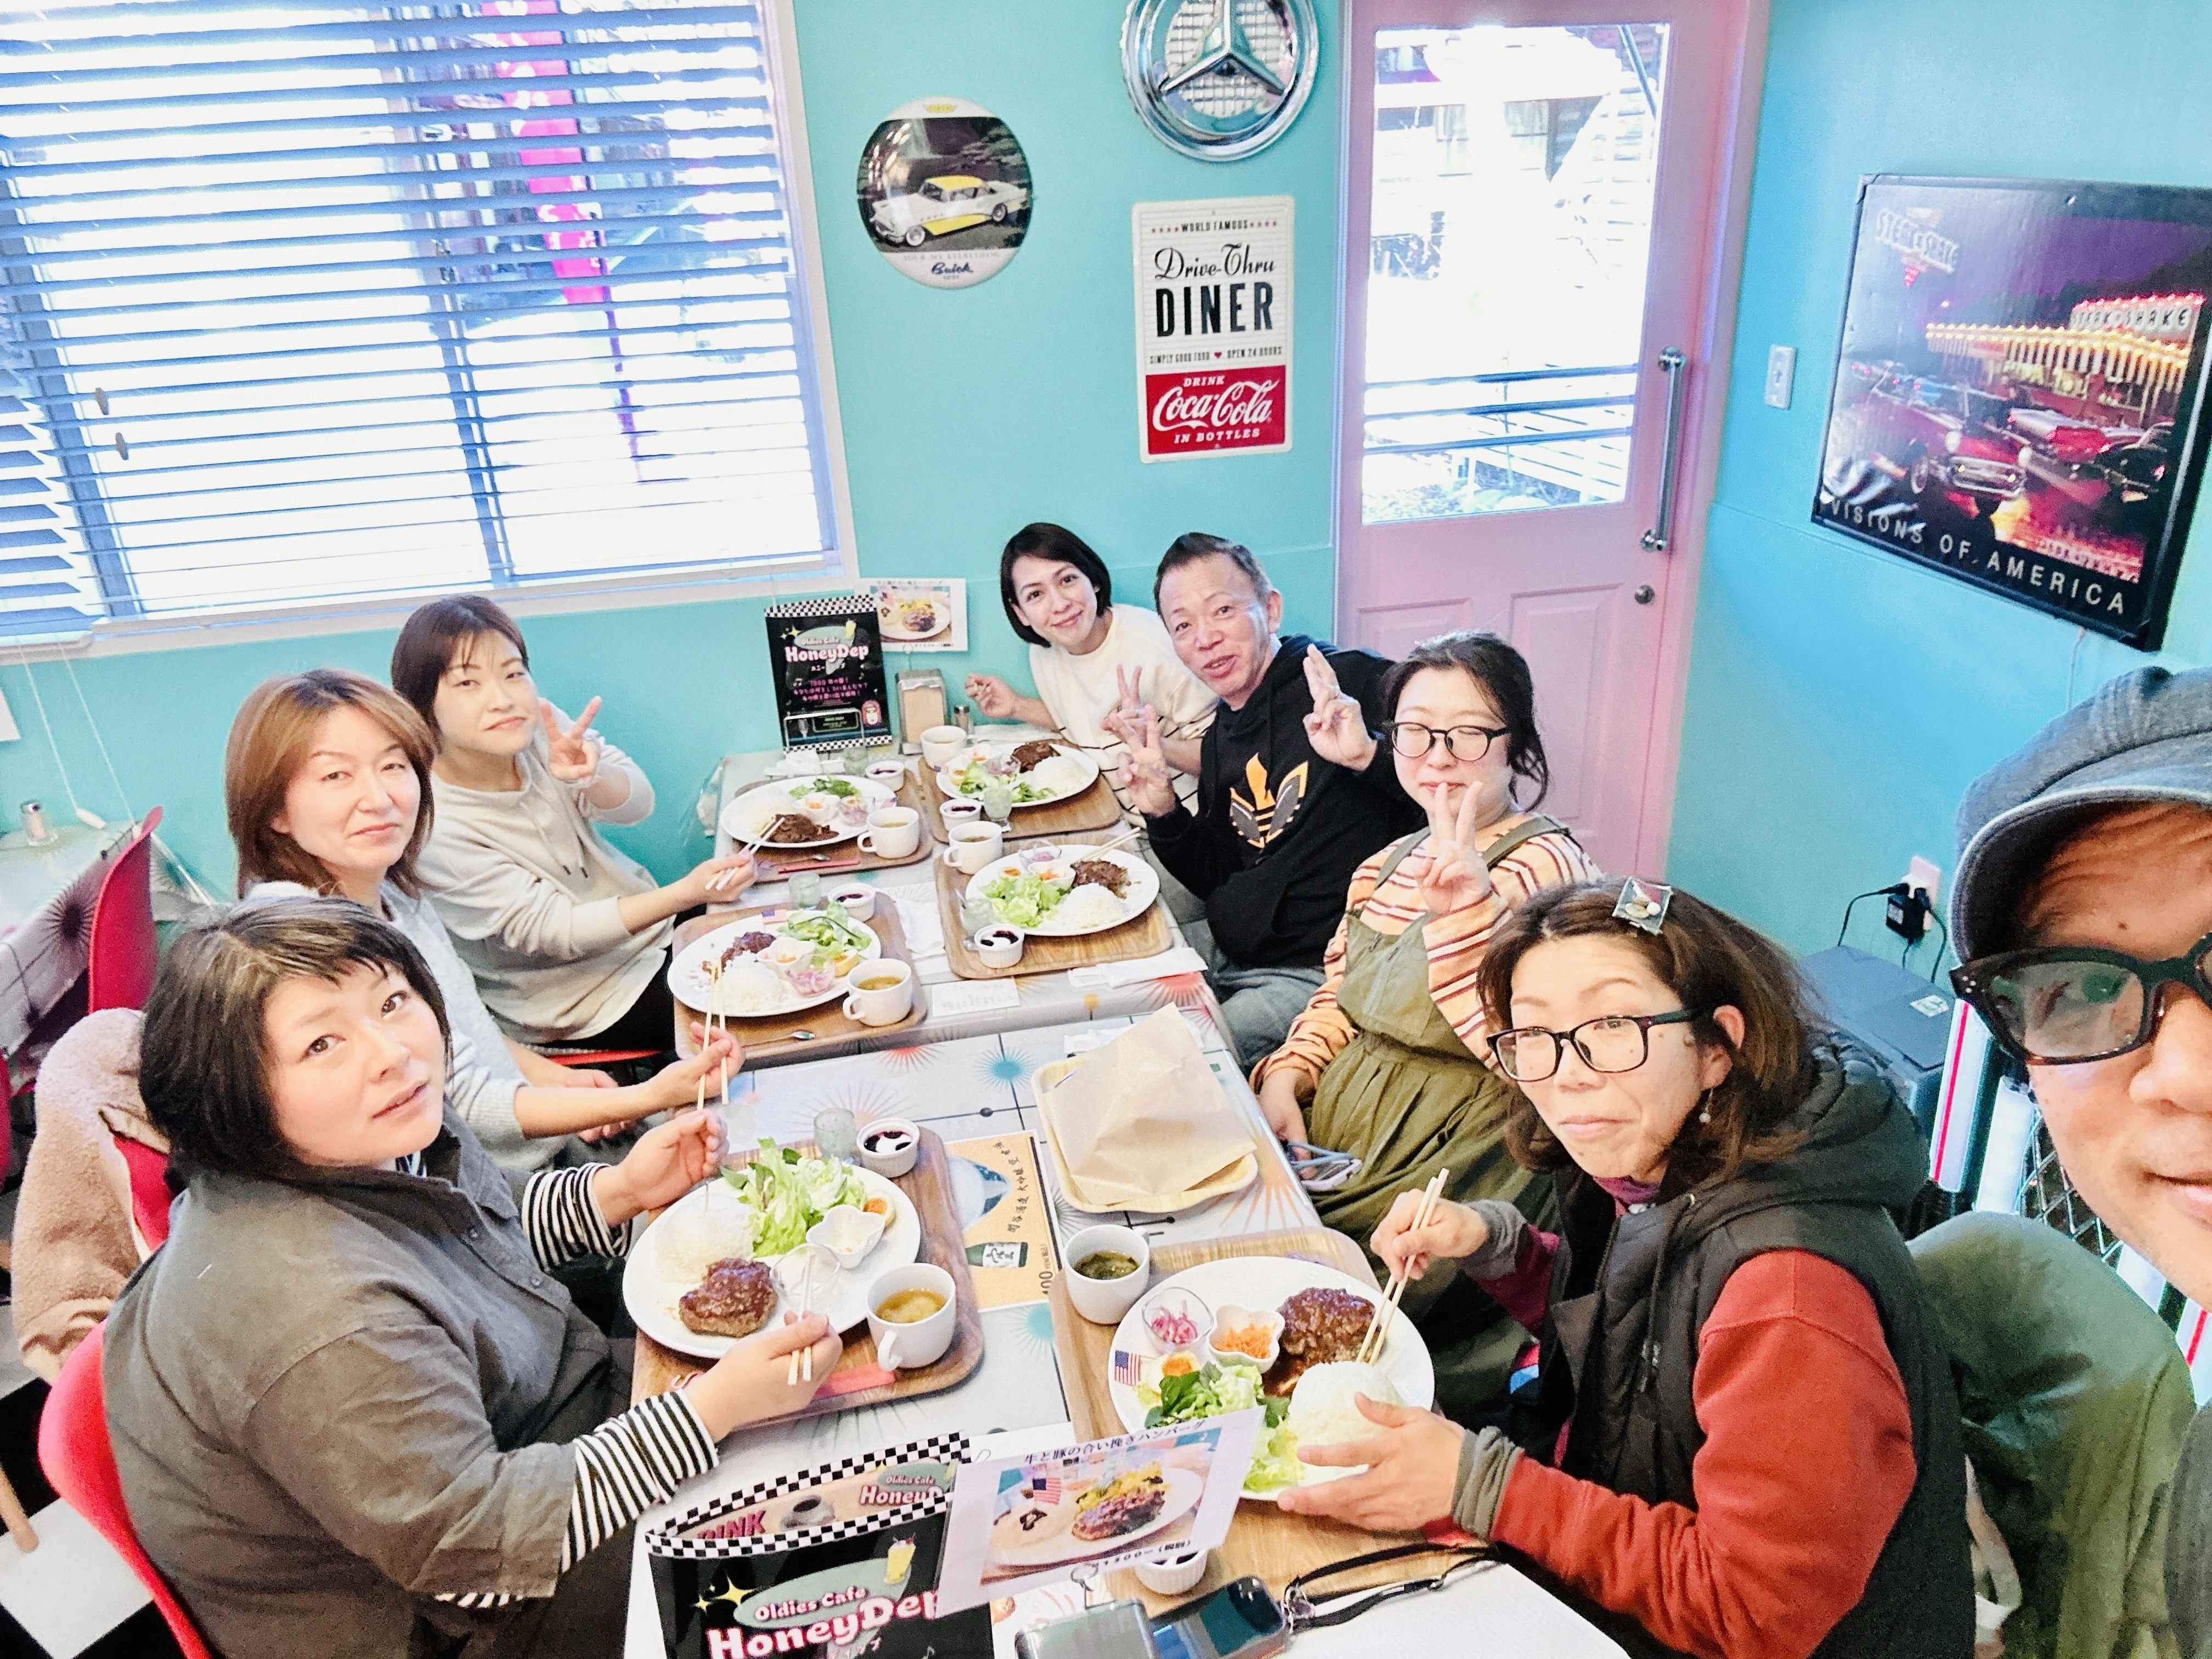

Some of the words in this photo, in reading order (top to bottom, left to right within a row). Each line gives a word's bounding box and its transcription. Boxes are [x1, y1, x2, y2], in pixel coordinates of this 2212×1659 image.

[1182, 222, 1210, 233] WORLD
[1214, 219, 1248, 231] FAMOUS
[931, 261, 974, 275] Buick
[1154, 242, 1275, 280] Drive-Thru
[1156, 281, 1273, 337] DINER
[1150, 355, 1173, 364] SIMPLY
[1175, 353, 1192, 363] GOOD
[1227, 349, 1245, 359] OPEN
[1248, 347, 1257, 357] 24
[1259, 346, 1283, 357] HOURS
[1183, 375, 1226, 387] DRINK
[1153, 379, 1280, 432] Coca-Cola
[1173, 433, 1190, 444] IN
[1195, 428, 1261, 442] BOTTLES
[1832, 498, 1923, 544] VISIONS
[1939, 534, 1971, 559] OF
[1987, 550, 2124, 615] AMERICA
[785, 644, 869, 663] HoneyDep
[754, 1599, 820, 1621] Oldies
[822, 1585, 868, 1608] Cafe
